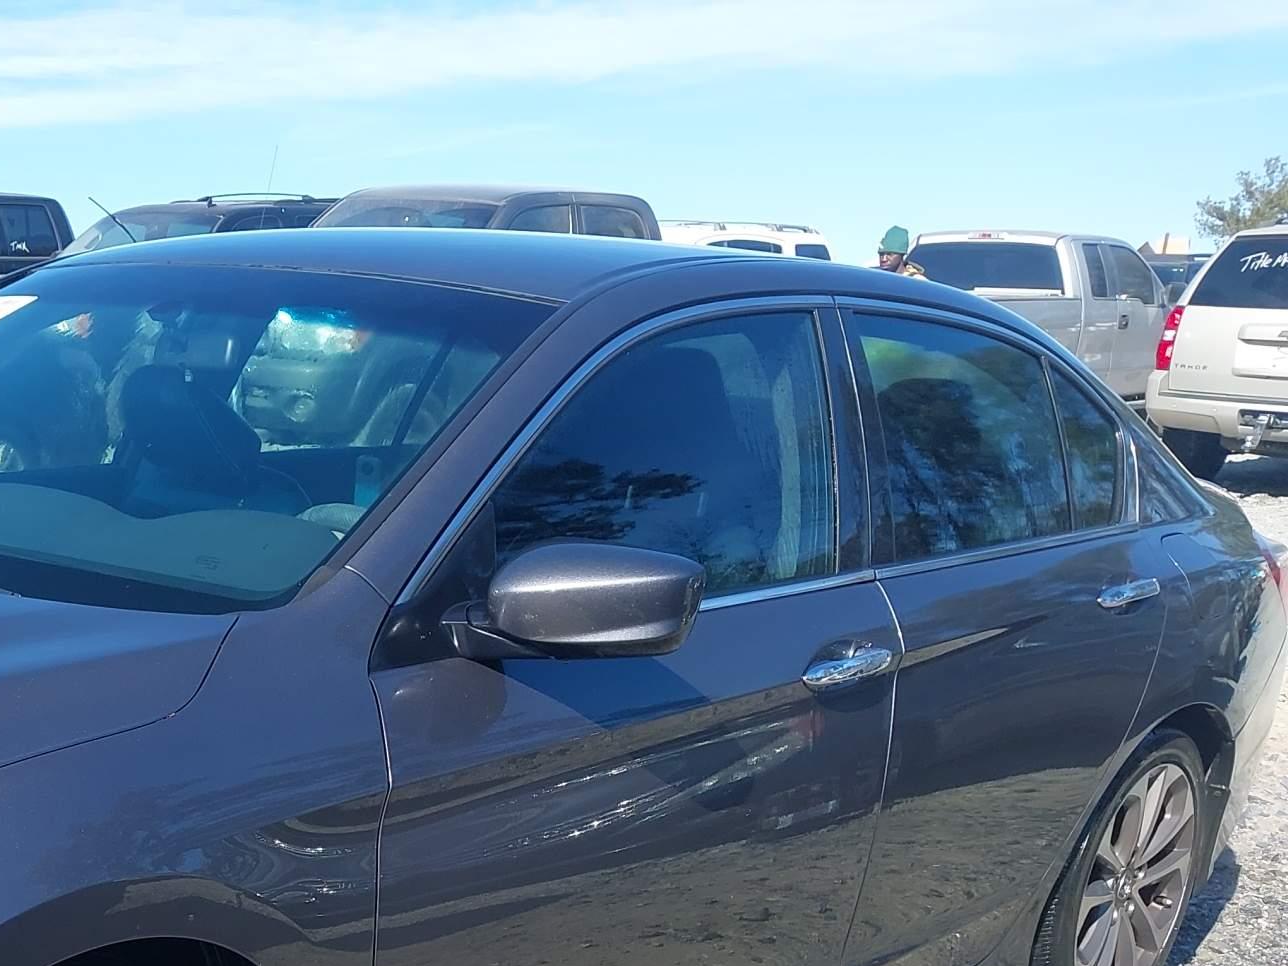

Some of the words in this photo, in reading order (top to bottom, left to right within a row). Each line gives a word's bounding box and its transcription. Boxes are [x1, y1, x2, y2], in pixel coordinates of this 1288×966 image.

[9, 240, 30, 253] TMX
[1240, 251, 1273, 273] Title
[1174, 363, 1208, 371] TAHOE
